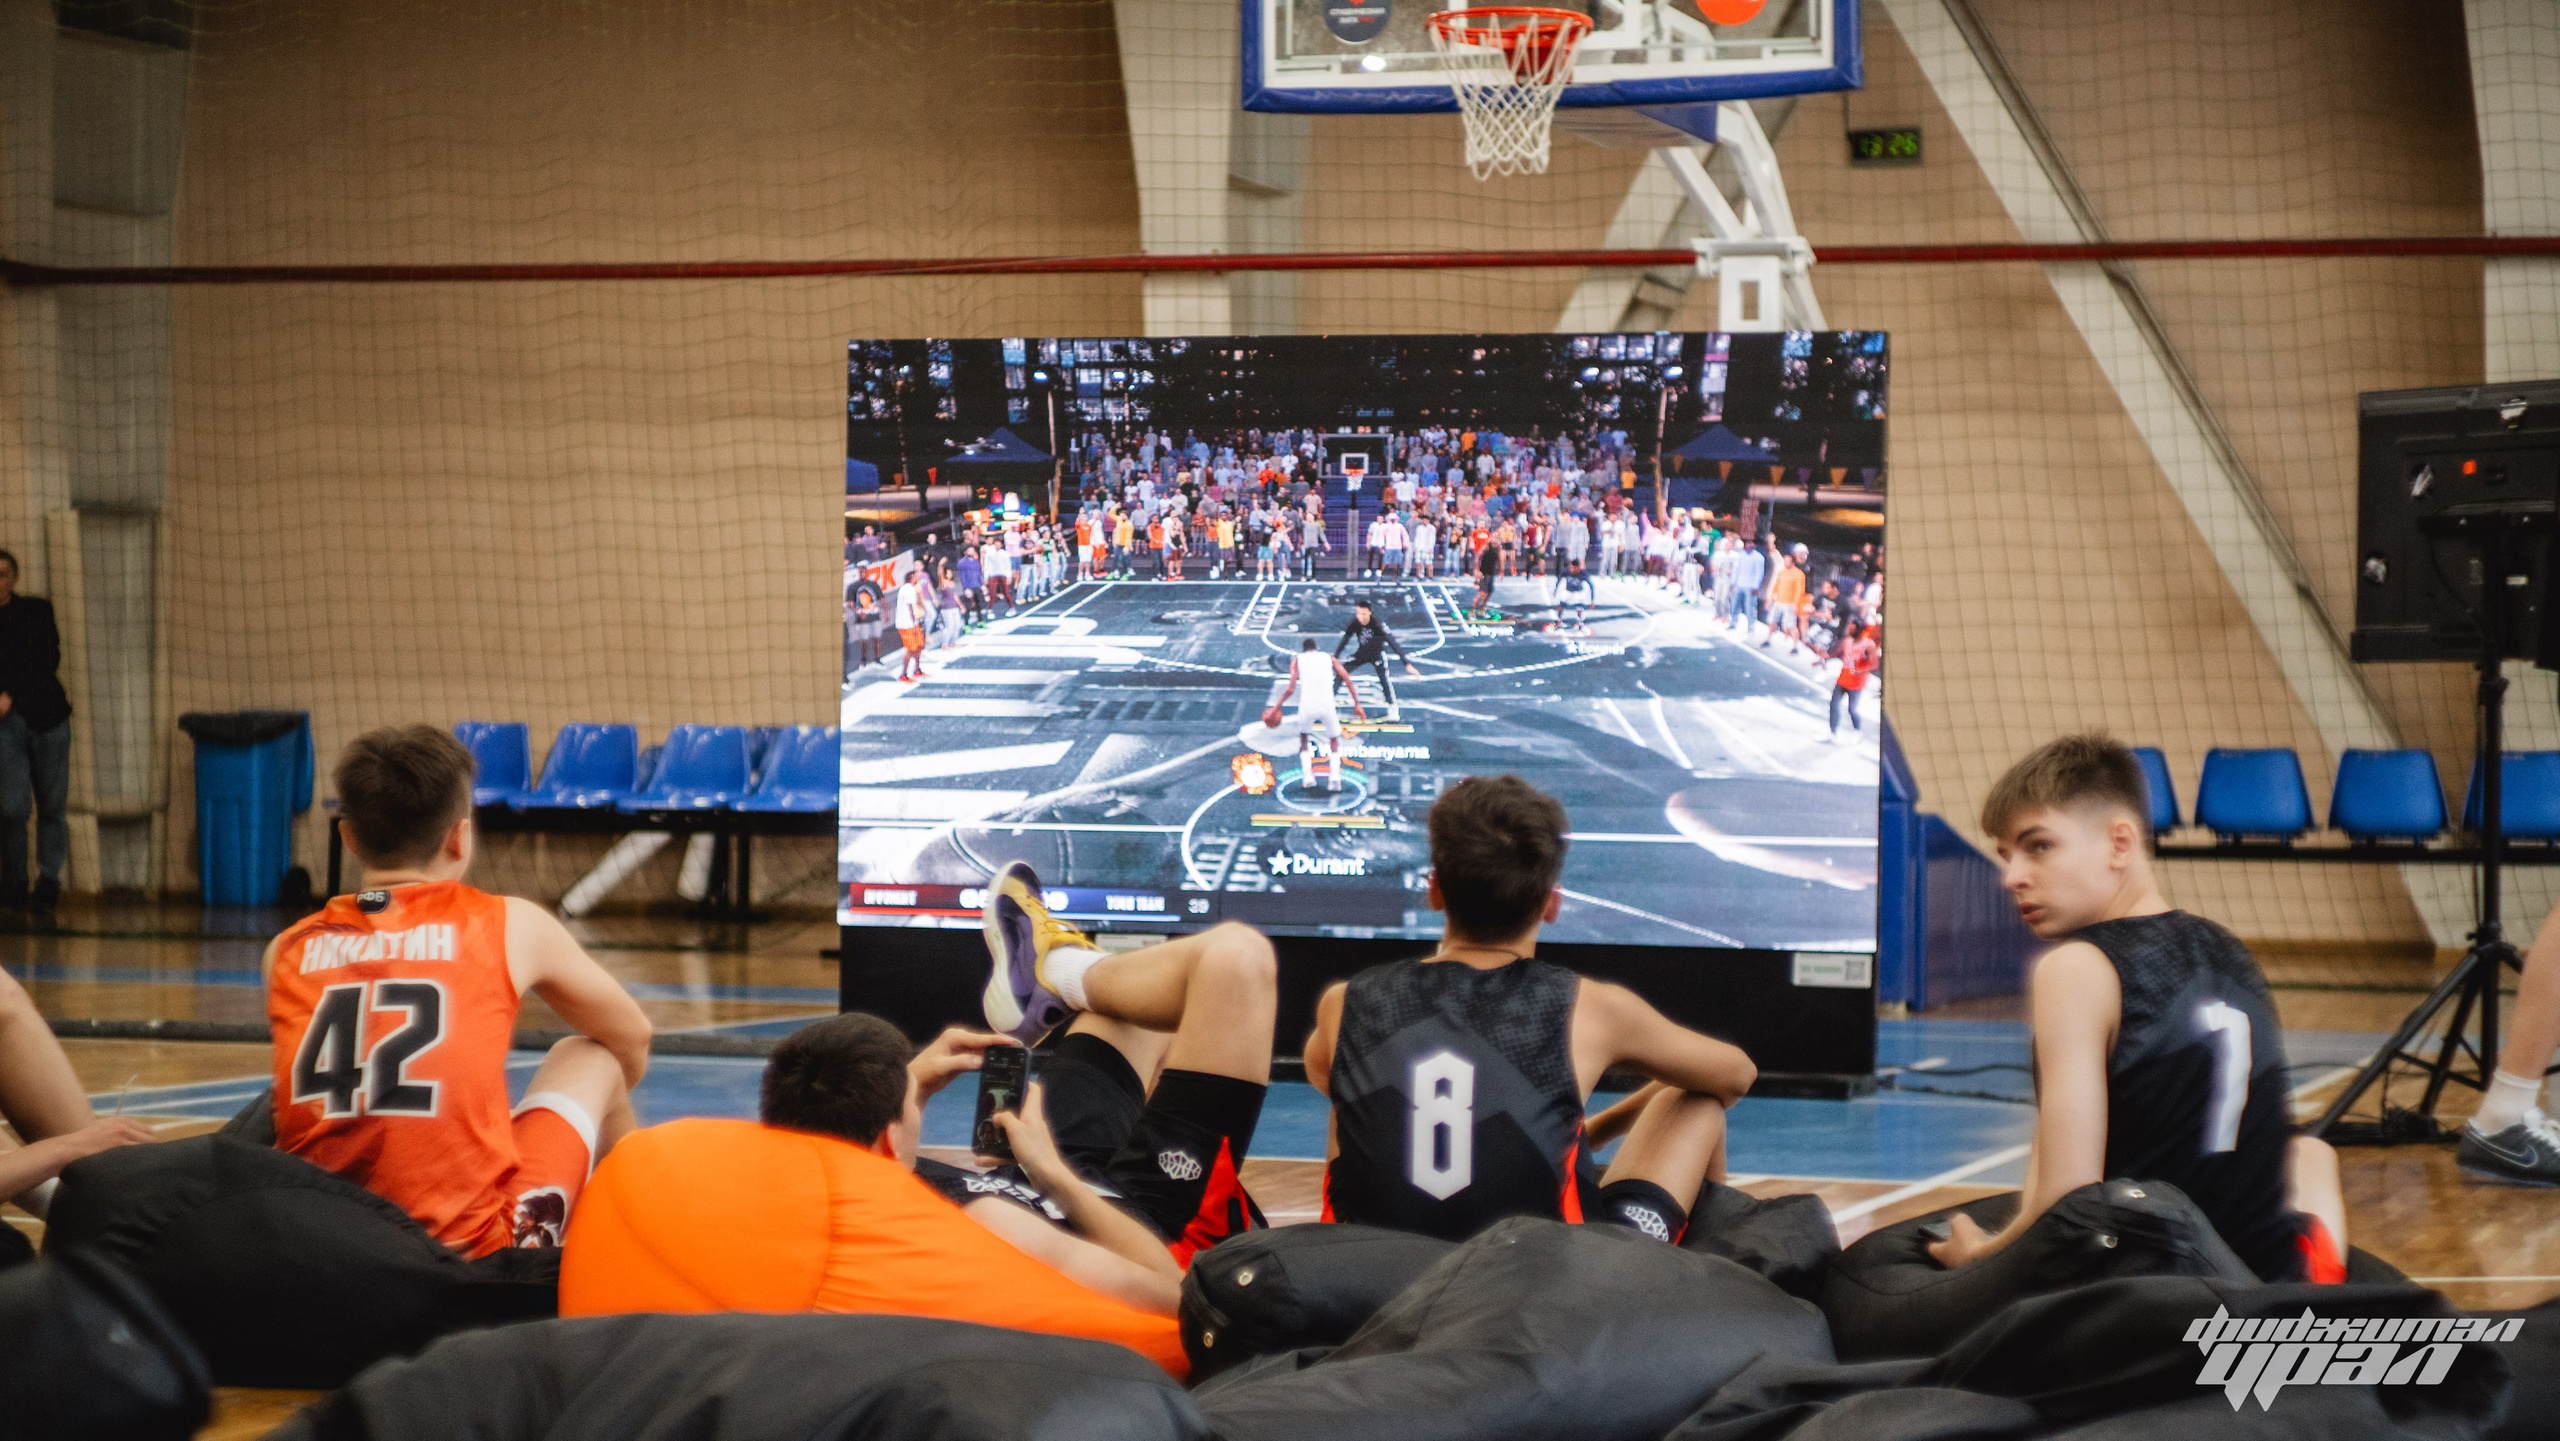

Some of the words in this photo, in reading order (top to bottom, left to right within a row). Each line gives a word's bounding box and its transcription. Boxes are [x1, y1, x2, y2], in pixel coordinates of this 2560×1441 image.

[1319, 744, 1431, 762] Wmbanyama
[1292, 852, 1366, 876] Durant
[291, 978, 446, 1120] 42
[2204, 1000, 2254, 1153] 1
[1411, 1050, 1475, 1202] 8
